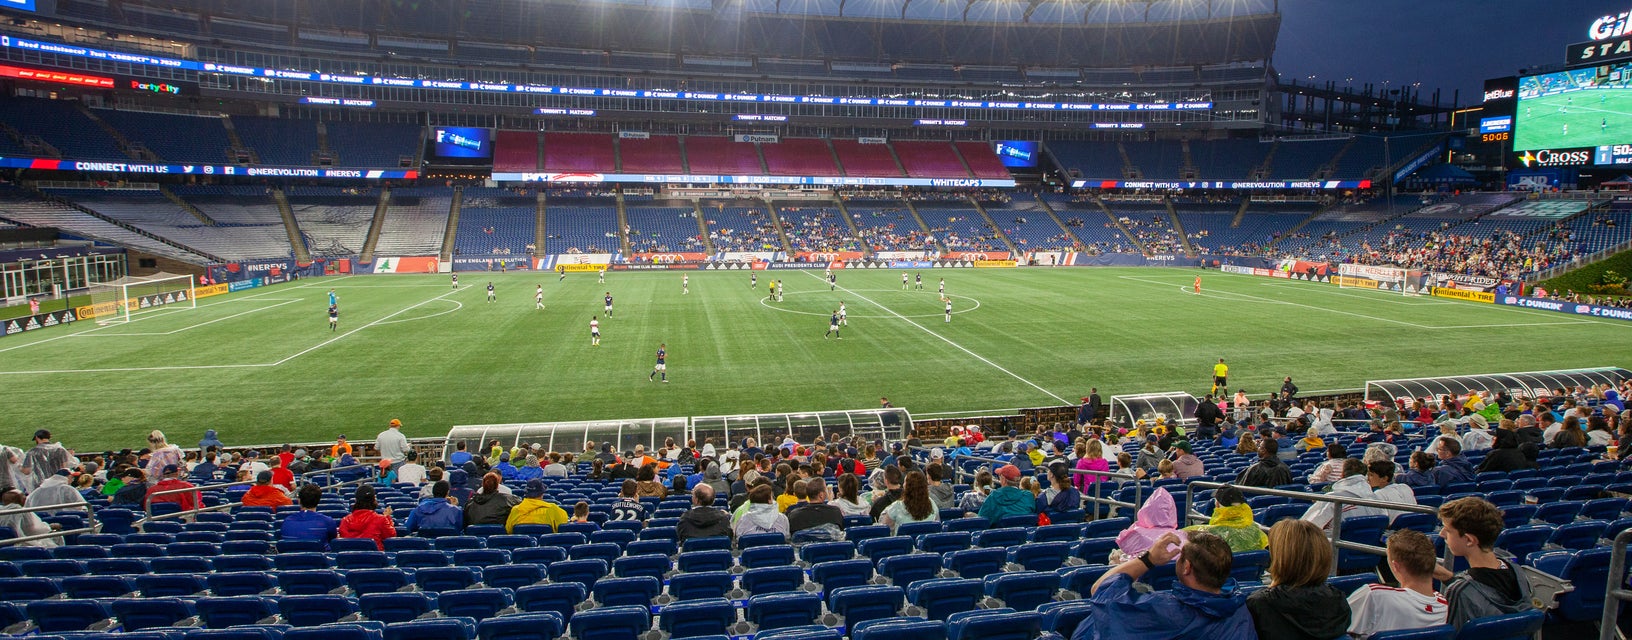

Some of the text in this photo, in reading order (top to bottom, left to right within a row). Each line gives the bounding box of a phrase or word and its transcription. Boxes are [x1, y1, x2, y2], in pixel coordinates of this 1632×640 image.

[131, 80, 180, 94] PartyCity
[1483, 89, 1514, 102] jetBlue
[76, 162, 126, 172] CONNECT
[248, 168, 318, 177] @NEREVOLUTION
[933, 179, 980, 187] WHITECAPS
[1434, 287, 1494, 302] Continental TIRE
[1526, 299, 1563, 311] DUNKIN'
[615, 509, 637, 521] 22
